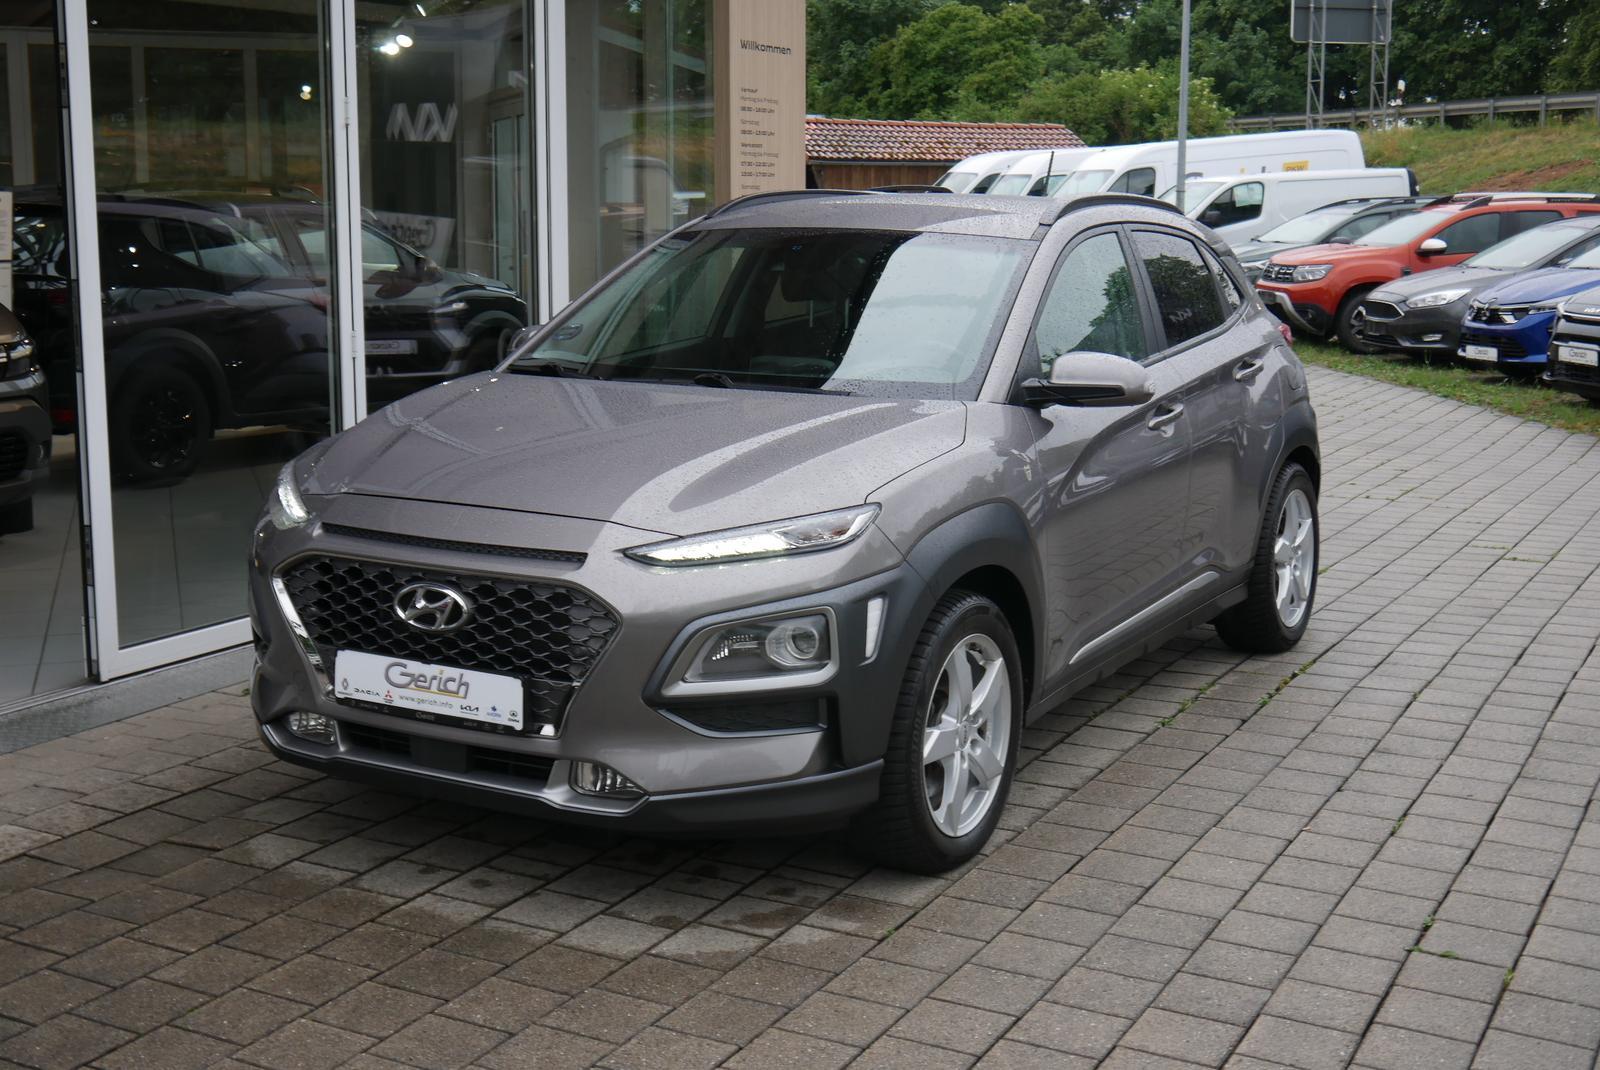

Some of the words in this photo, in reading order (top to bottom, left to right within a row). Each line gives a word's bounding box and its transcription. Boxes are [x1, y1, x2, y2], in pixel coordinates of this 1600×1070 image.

[740, 38, 792, 55] Willkommen
[384, 661, 471, 700] Gerich
[354, 687, 380, 697] DACIA
[399, 694, 454, 709] www.gerich.info
[460, 704, 479, 713] KIA
